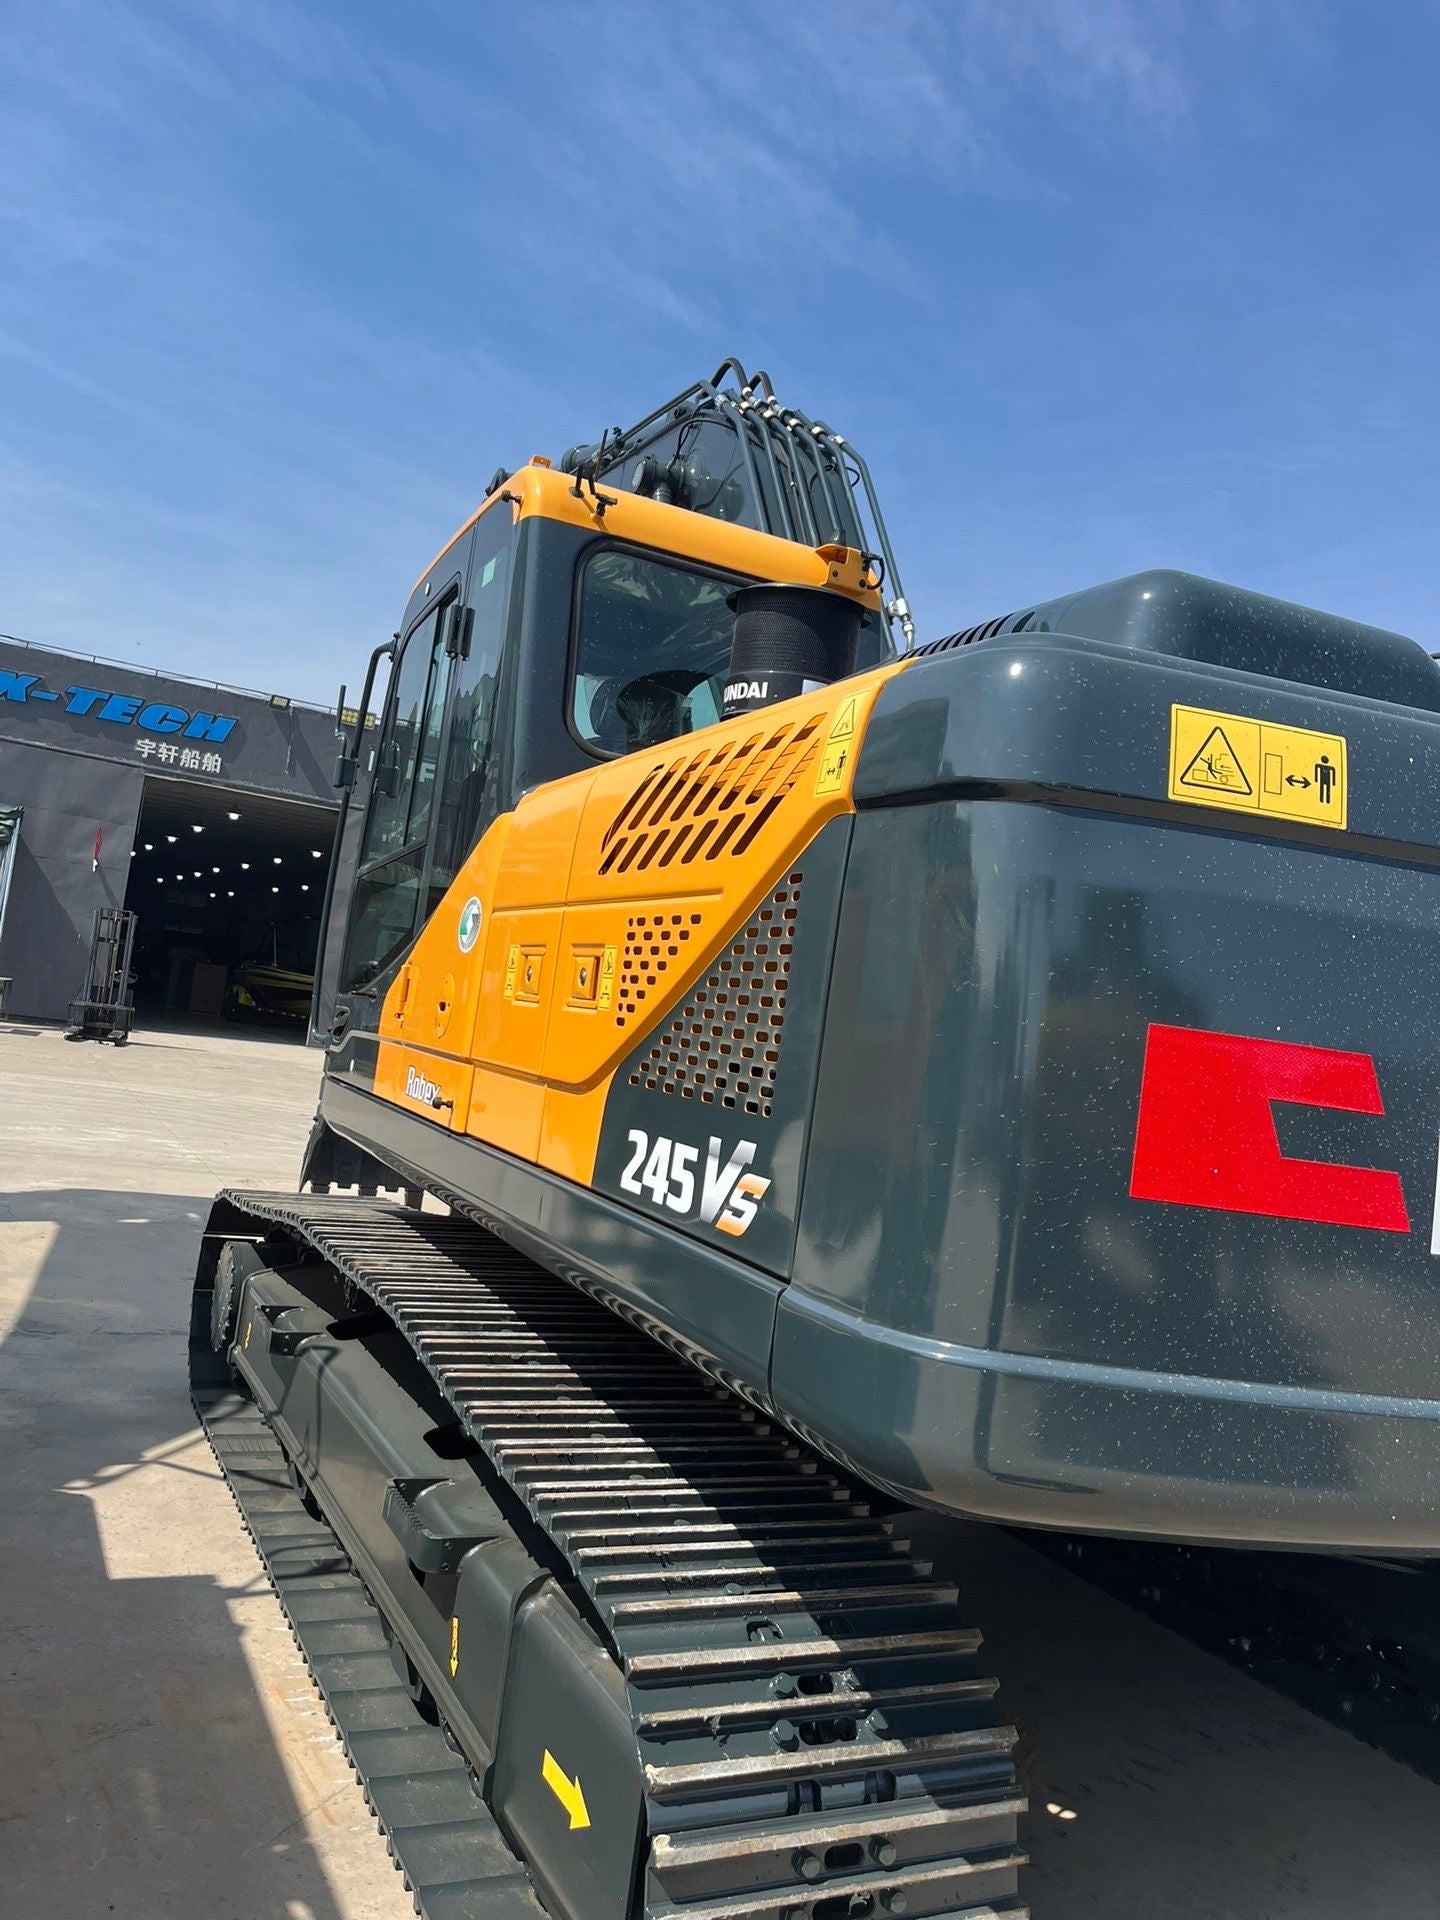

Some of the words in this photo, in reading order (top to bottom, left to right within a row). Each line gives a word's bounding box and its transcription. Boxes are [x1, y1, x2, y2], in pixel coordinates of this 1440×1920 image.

[134, 738, 222, 773] 宇轩船舶
[405, 1065, 441, 1106] Robex
